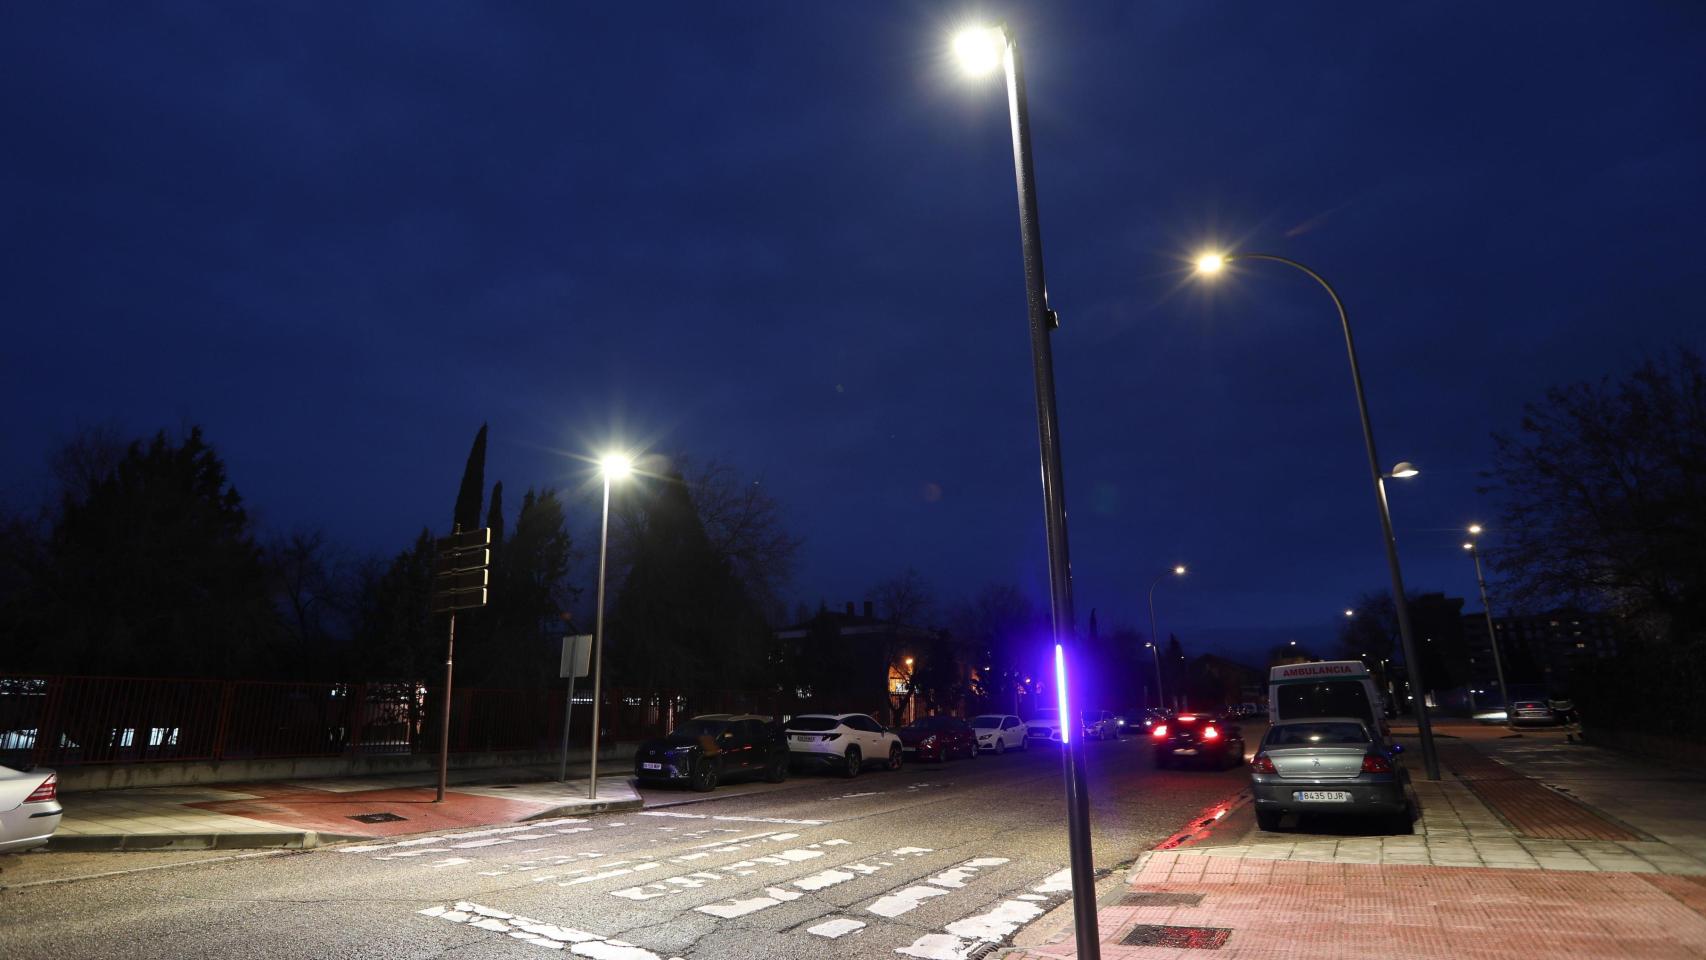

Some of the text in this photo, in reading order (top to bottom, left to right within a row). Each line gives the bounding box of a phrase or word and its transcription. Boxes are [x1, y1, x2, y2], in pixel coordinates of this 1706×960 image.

[1283, 665, 1352, 677] AMBULANCIA
[1304, 792, 1344, 800] 8435 DJR
